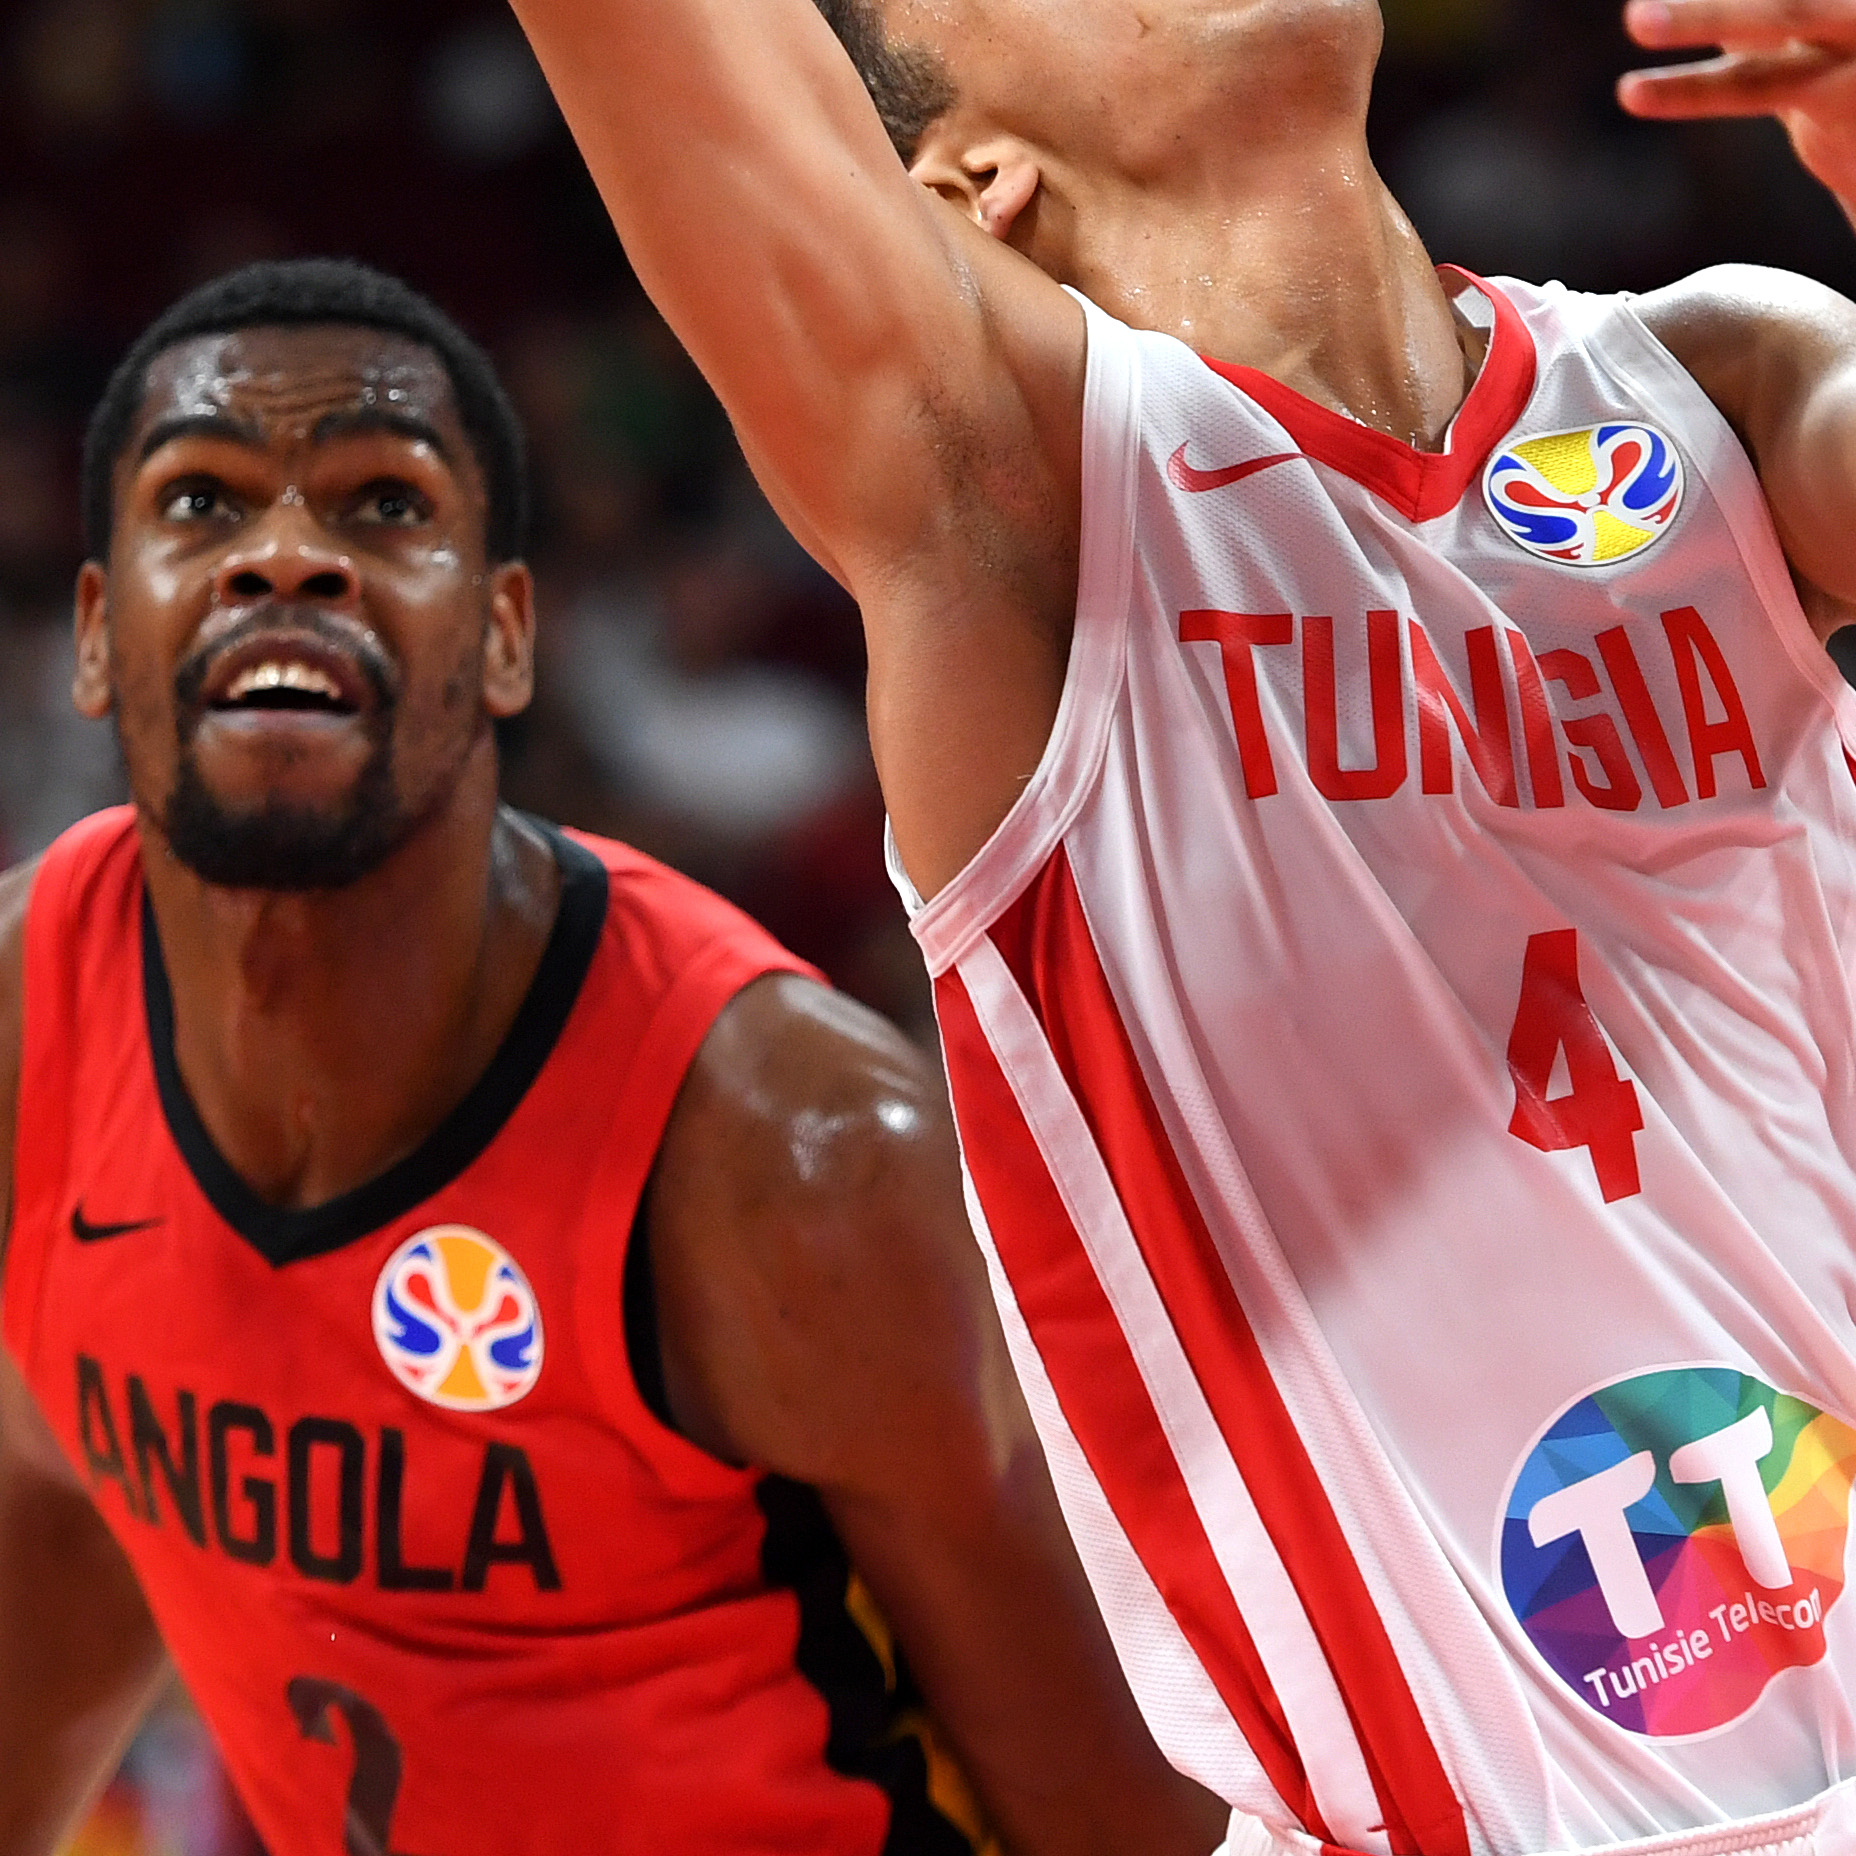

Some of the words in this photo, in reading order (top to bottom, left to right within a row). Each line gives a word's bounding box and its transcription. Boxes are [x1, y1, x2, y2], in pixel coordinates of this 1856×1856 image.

[1179, 606, 1767, 811] TUNISIA
[1508, 929, 1644, 1203] 4
[75, 1352, 563, 1592] ANGOLA
[1584, 1628, 1713, 1707] Tunisie
